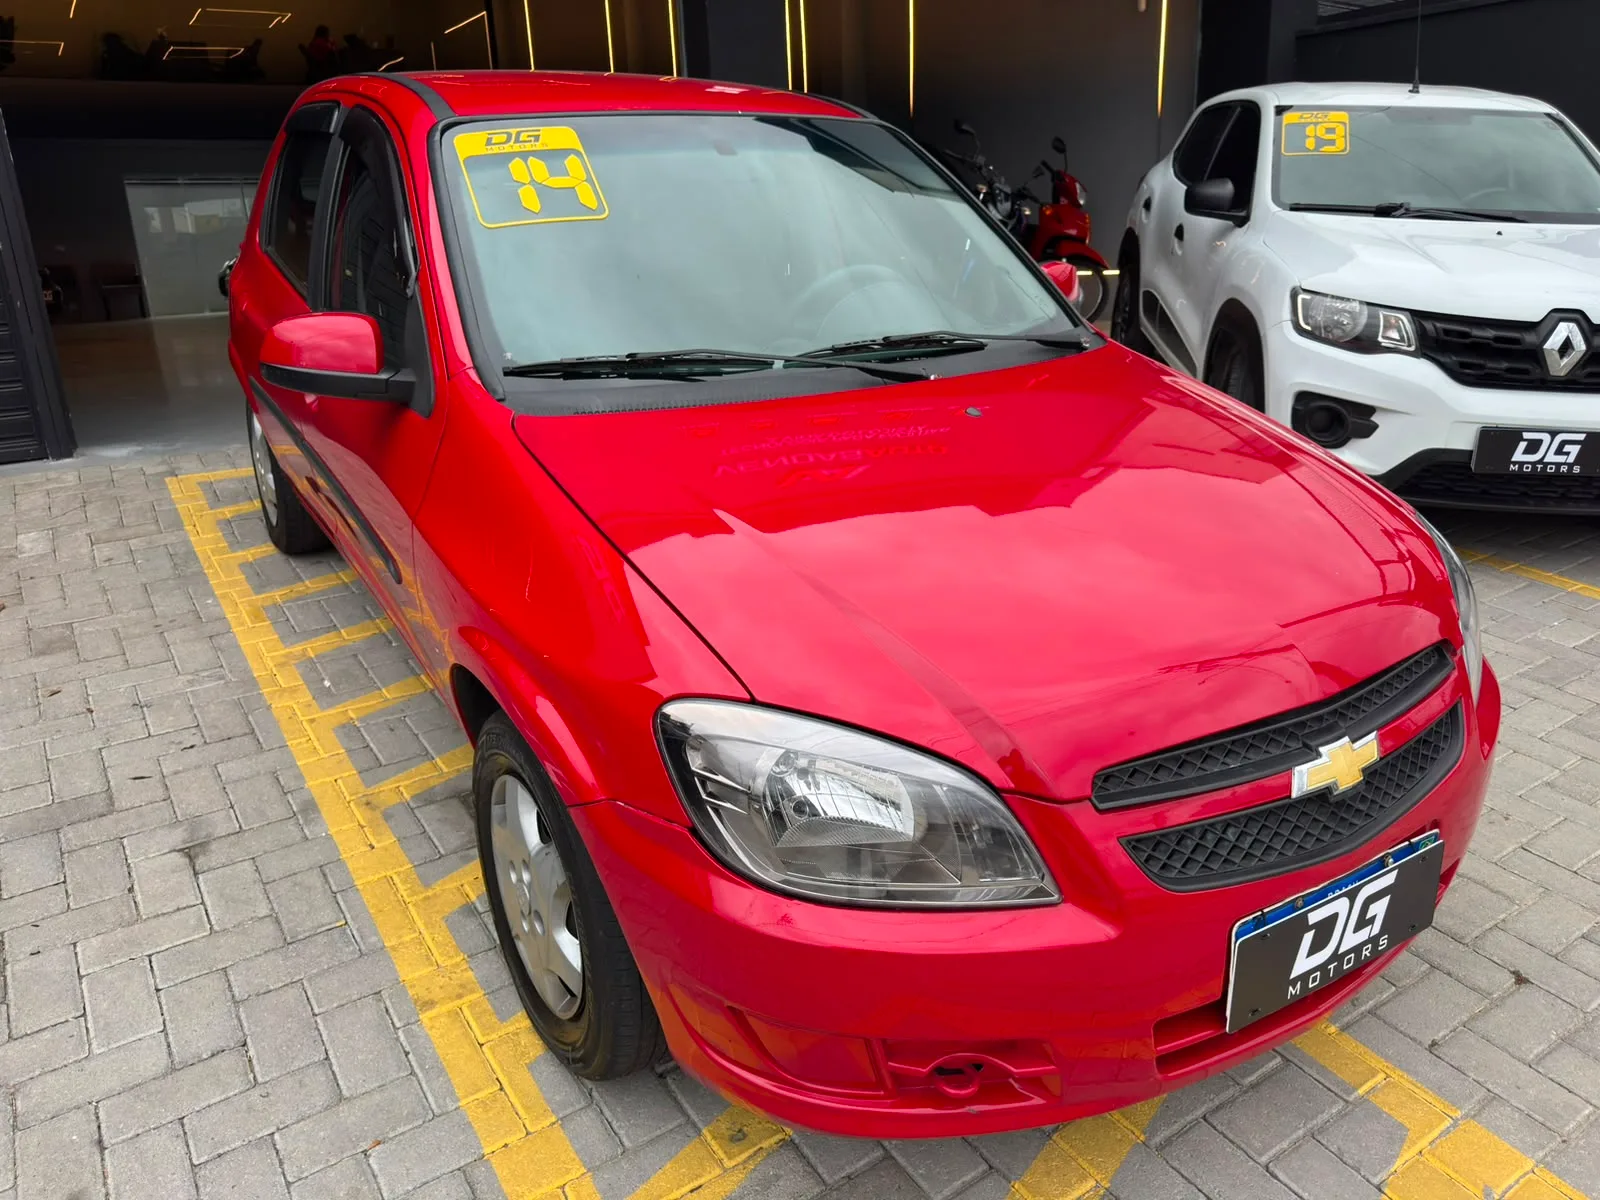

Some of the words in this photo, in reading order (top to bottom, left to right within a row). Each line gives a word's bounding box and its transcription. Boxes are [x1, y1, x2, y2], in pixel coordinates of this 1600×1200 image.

[485, 129, 542, 146] DG
[1305, 124, 1345, 152] 19
[508, 154, 598, 214] 14
[1511, 432, 1587, 463] DG
[1509, 464, 1581, 473] MOTORS
[1289, 868, 1399, 980] DG
[1288, 935, 1389, 999] MOTORS
